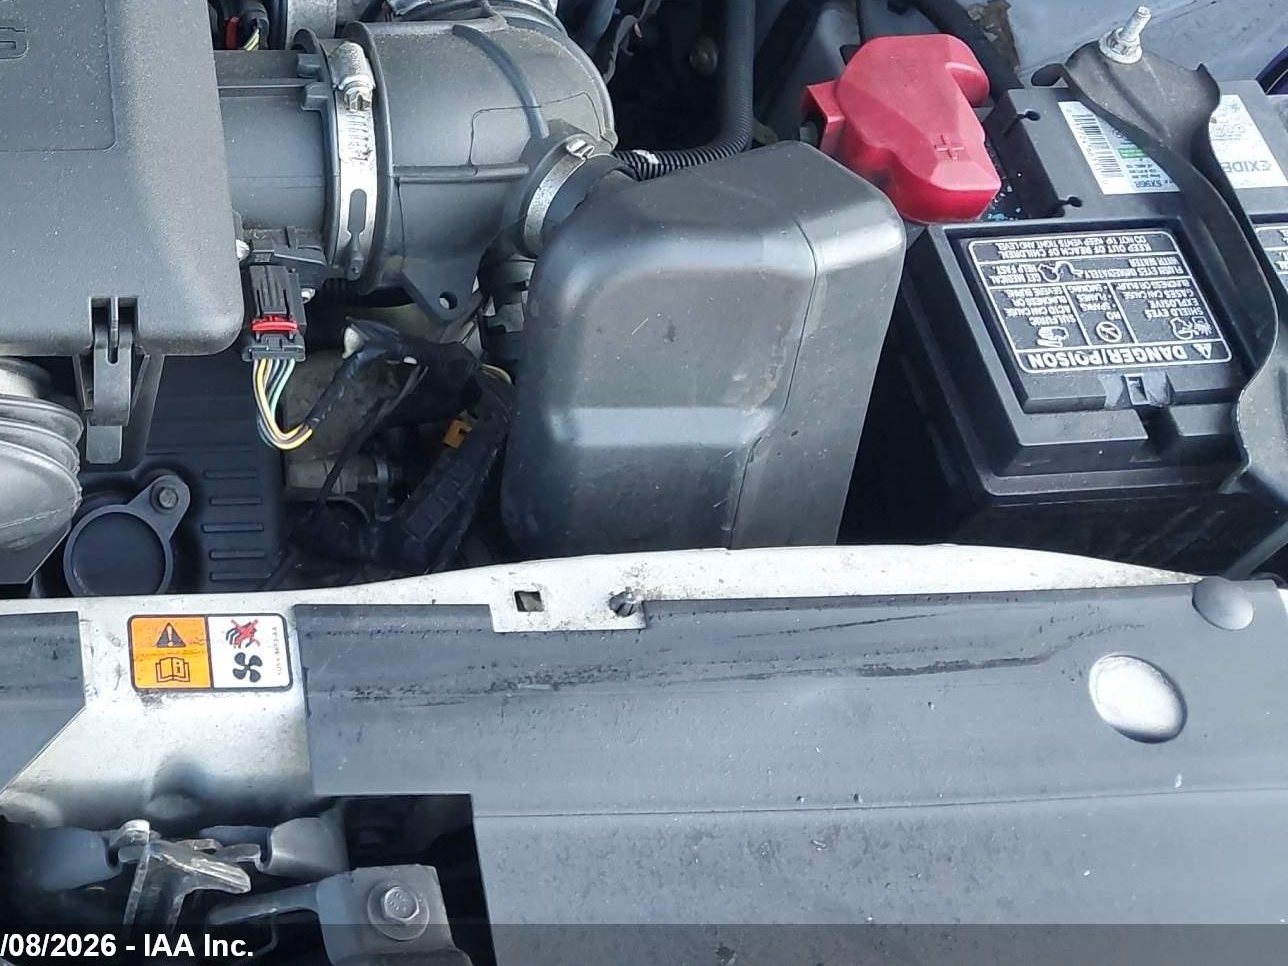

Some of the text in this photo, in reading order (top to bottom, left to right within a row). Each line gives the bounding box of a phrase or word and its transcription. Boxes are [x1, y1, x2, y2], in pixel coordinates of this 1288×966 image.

[1220, 160, 1272, 173] EXIDE
[1084, 238, 1104, 246] KEEP
[1133, 236, 1147, 244] DO
[1019, 242, 1035, 250] AND
[1093, 246, 1106, 254] OF
[1107, 245, 1126, 254] OUT
[1127, 243, 1152, 253] KEEP
[1048, 249, 1059, 257] OF
[1060, 246, 1093, 256] REACH
[1128, 256, 1179, 267] WITH WATER
[1018, 264, 1038, 273] HELP
[1137, 267, 1158, 276] EYES
[1158, 265, 1184, 275] FLUSH
[989, 274, 1042, 284] GET MEDICAL
[1032, 286, 1063, 297] SEVERE
[1067, 284, 1103, 293] SMOKING
[1076, 293, 1107, 302] FLAMES
[1164, 289, 1194, 298] GASES
[1079, 302, 1112, 311] SPARKS
[1148, 298, 1199, 309] EXPLOSIVE
[1031, 307, 1048, 315] CAN
[1048, 305, 1071, 314] ACID
[1144, 307, 1204, 319] SHIELD EYES
[1029, 314, 1076, 326] SULFURIC
[1106, 311, 1121, 320] NO
[1027, 345, 1188, 368] DANGER/POISON
